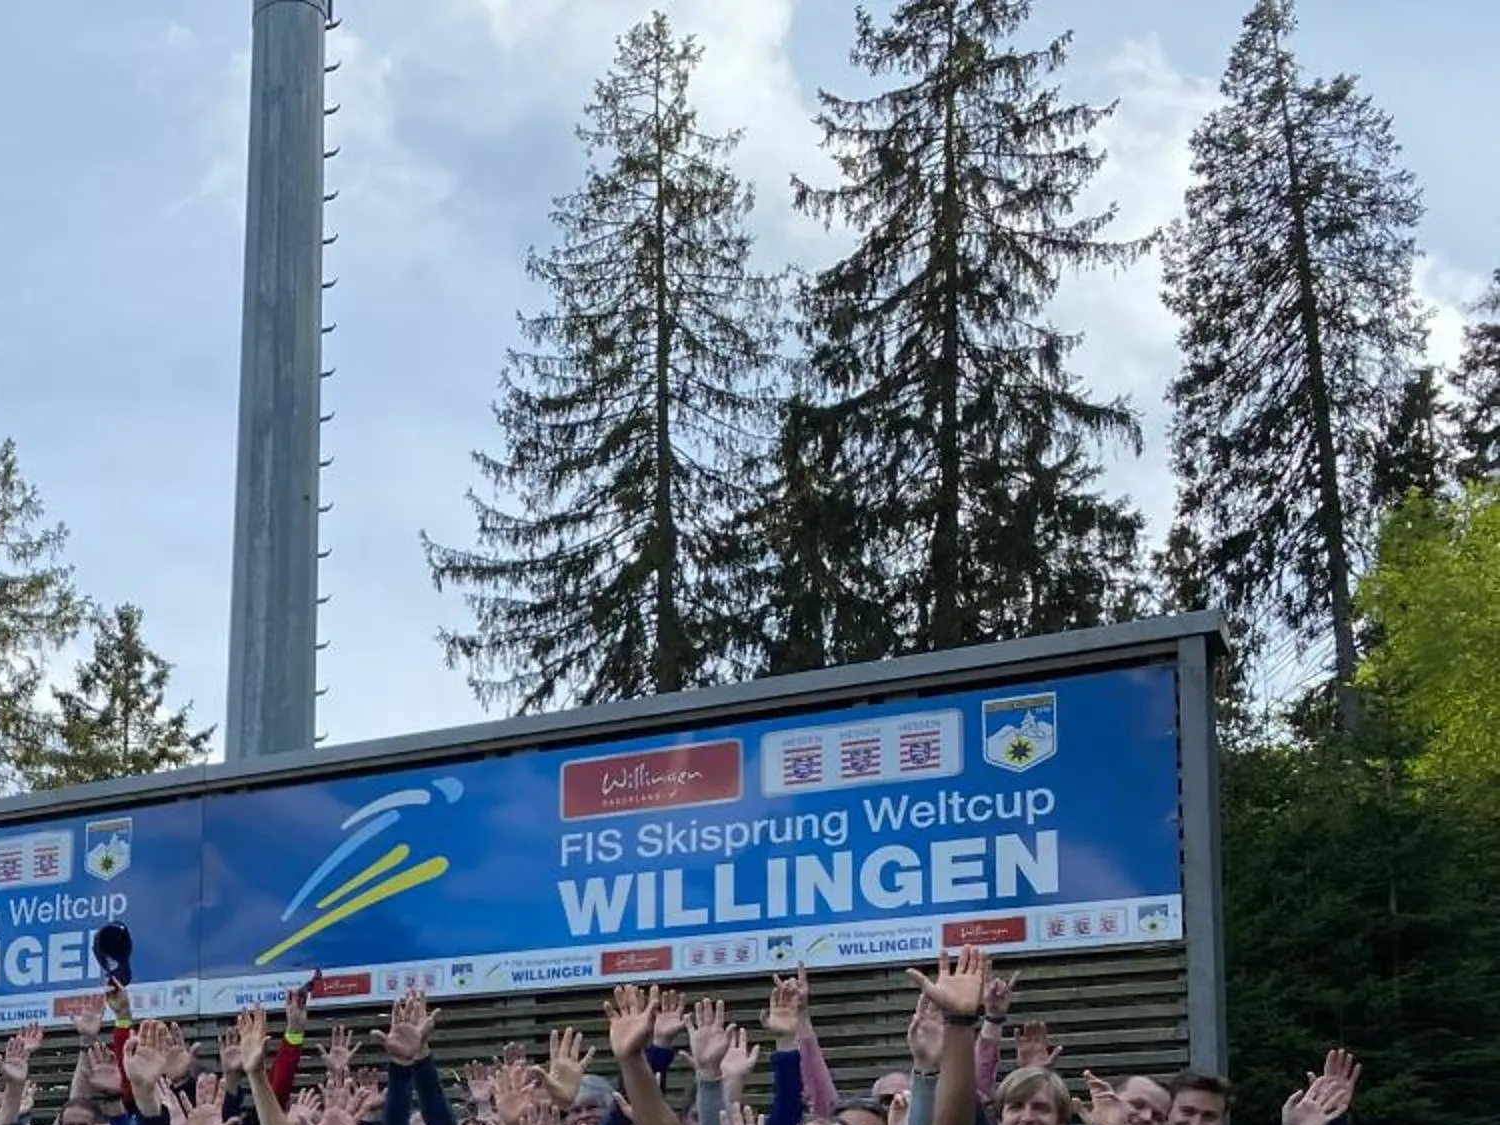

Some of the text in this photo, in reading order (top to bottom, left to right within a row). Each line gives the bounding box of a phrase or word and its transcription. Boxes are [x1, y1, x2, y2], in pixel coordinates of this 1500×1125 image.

[601, 762, 703, 799] Willingen
[560, 786, 1056, 867] FIS Skisprung Weltcup
[557, 830, 1060, 936] WILLINGEN
[9, 892, 127, 928] Weltcup
[837, 936, 933, 956] WILLINGEN
[510, 965, 593, 983] WILLINGEN
